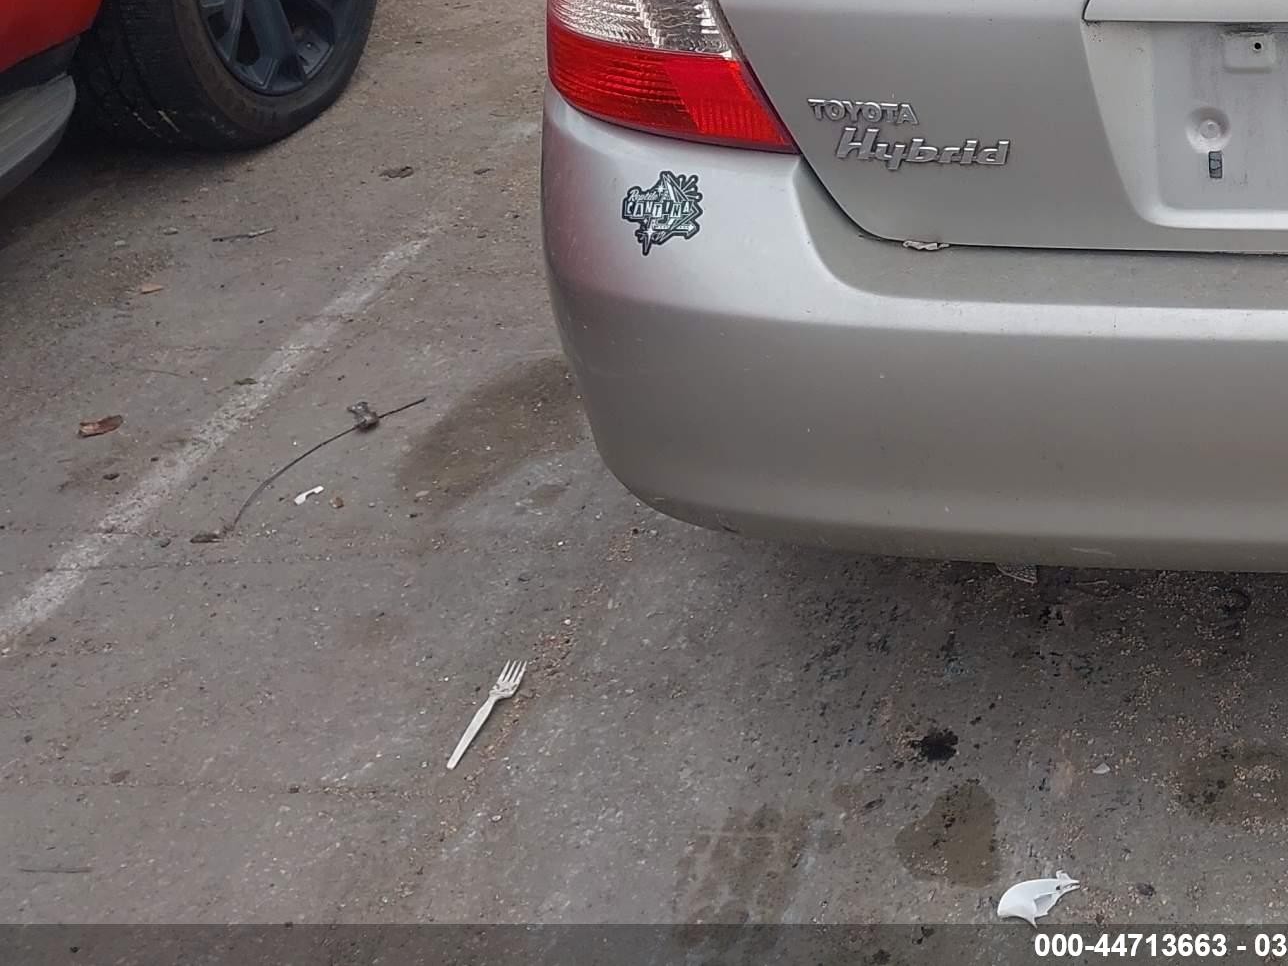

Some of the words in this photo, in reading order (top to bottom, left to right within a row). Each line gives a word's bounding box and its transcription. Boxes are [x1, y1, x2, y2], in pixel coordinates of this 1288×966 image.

[807, 98, 920, 125] TOYOTA
[835, 127, 1011, 171] Hybrid
[627, 201, 690, 217] CANTINA
